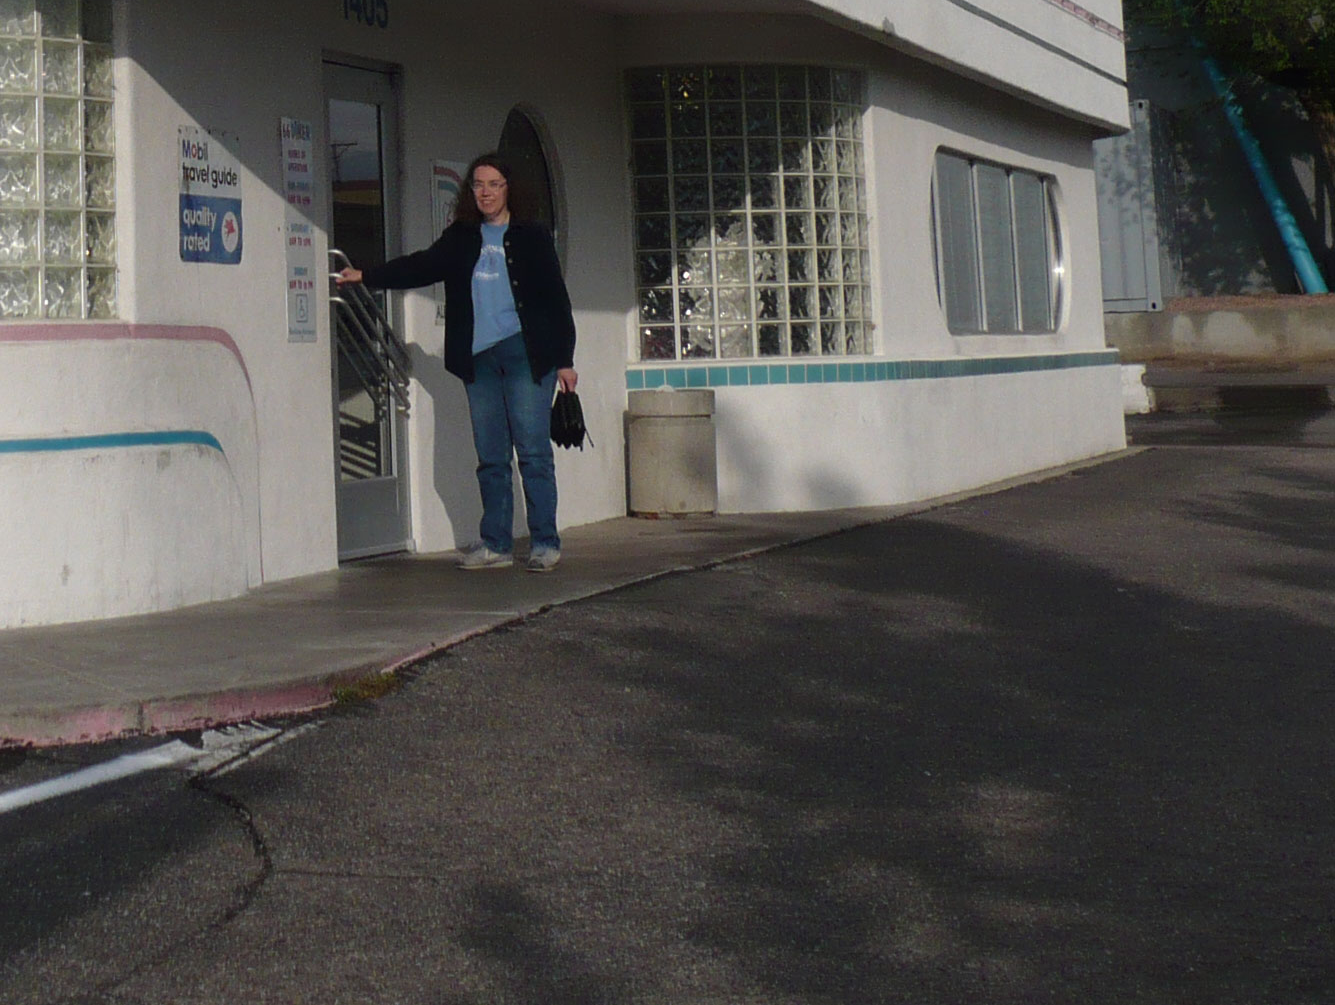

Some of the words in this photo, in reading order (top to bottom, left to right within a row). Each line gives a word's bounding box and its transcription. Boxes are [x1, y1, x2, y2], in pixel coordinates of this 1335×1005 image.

[182, 139, 208, 161] Mobil
[182, 162, 210, 183] travel
[211, 169, 238, 188] guide
[183, 207, 217, 231] quality
[183, 233, 210, 253] rated
